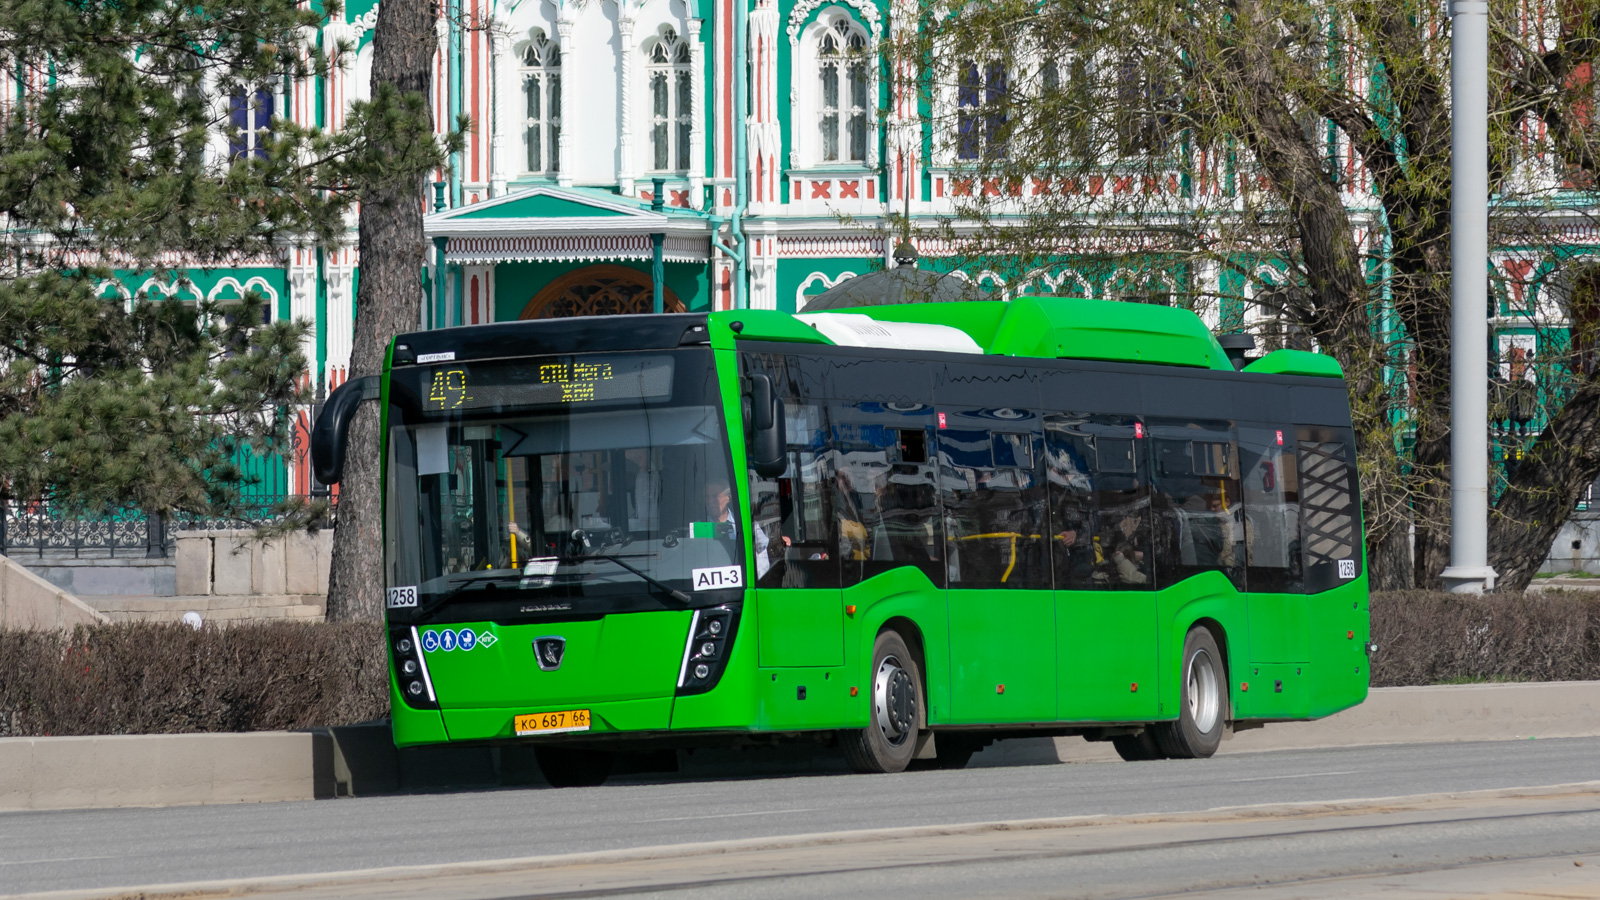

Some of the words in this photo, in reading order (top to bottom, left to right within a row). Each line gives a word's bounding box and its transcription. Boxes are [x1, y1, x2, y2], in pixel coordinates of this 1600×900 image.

[540, 364, 569, 383] СТЦ
[574, 363, 613, 381] Мега
[561, 383, 594, 402] ЖБИ
[1340, 562, 1354, 576] 1258
[698, 570, 739, 587] АП-3
[388, 588, 415, 606] 1258
[542, 713, 565, 728] 687
[573, 711, 586, 722] 66
